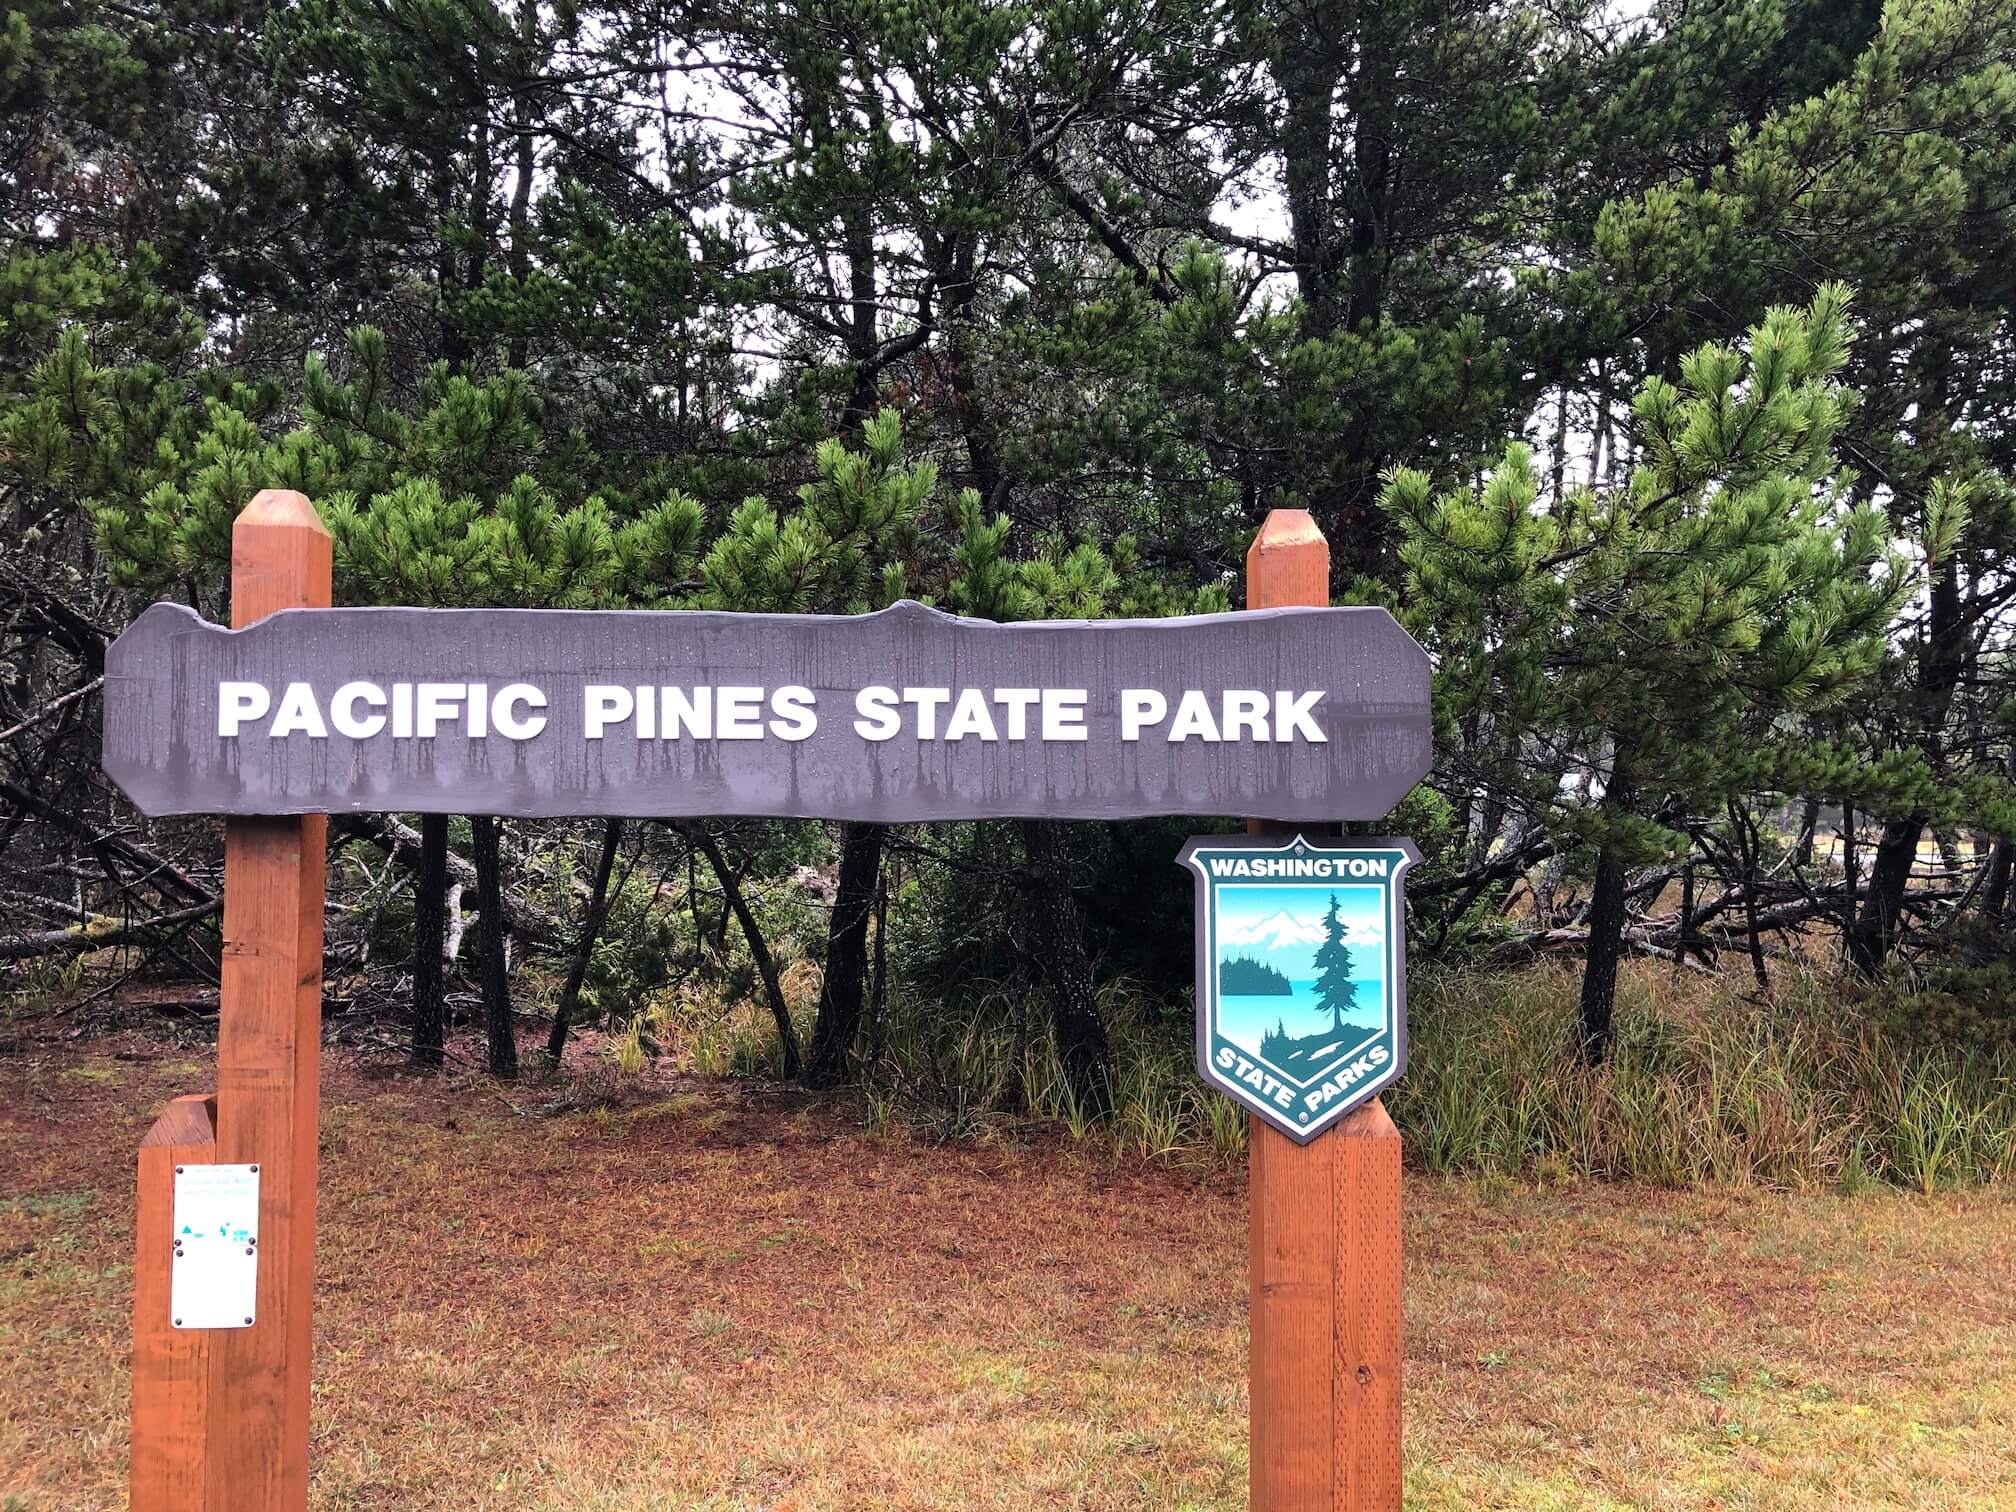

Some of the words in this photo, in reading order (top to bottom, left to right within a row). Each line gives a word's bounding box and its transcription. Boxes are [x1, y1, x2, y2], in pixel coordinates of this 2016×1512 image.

[217, 681, 548, 740] PACIFIC
[584, 685, 818, 741] PINES
[853, 685, 1088, 742] STATE
[1121, 688, 1328, 743] PARK
[1210, 858, 1387, 877] WASHINGTON
[1216, 1047, 1297, 1108] STATE
[1303, 1045, 1389, 1113] PARKS
